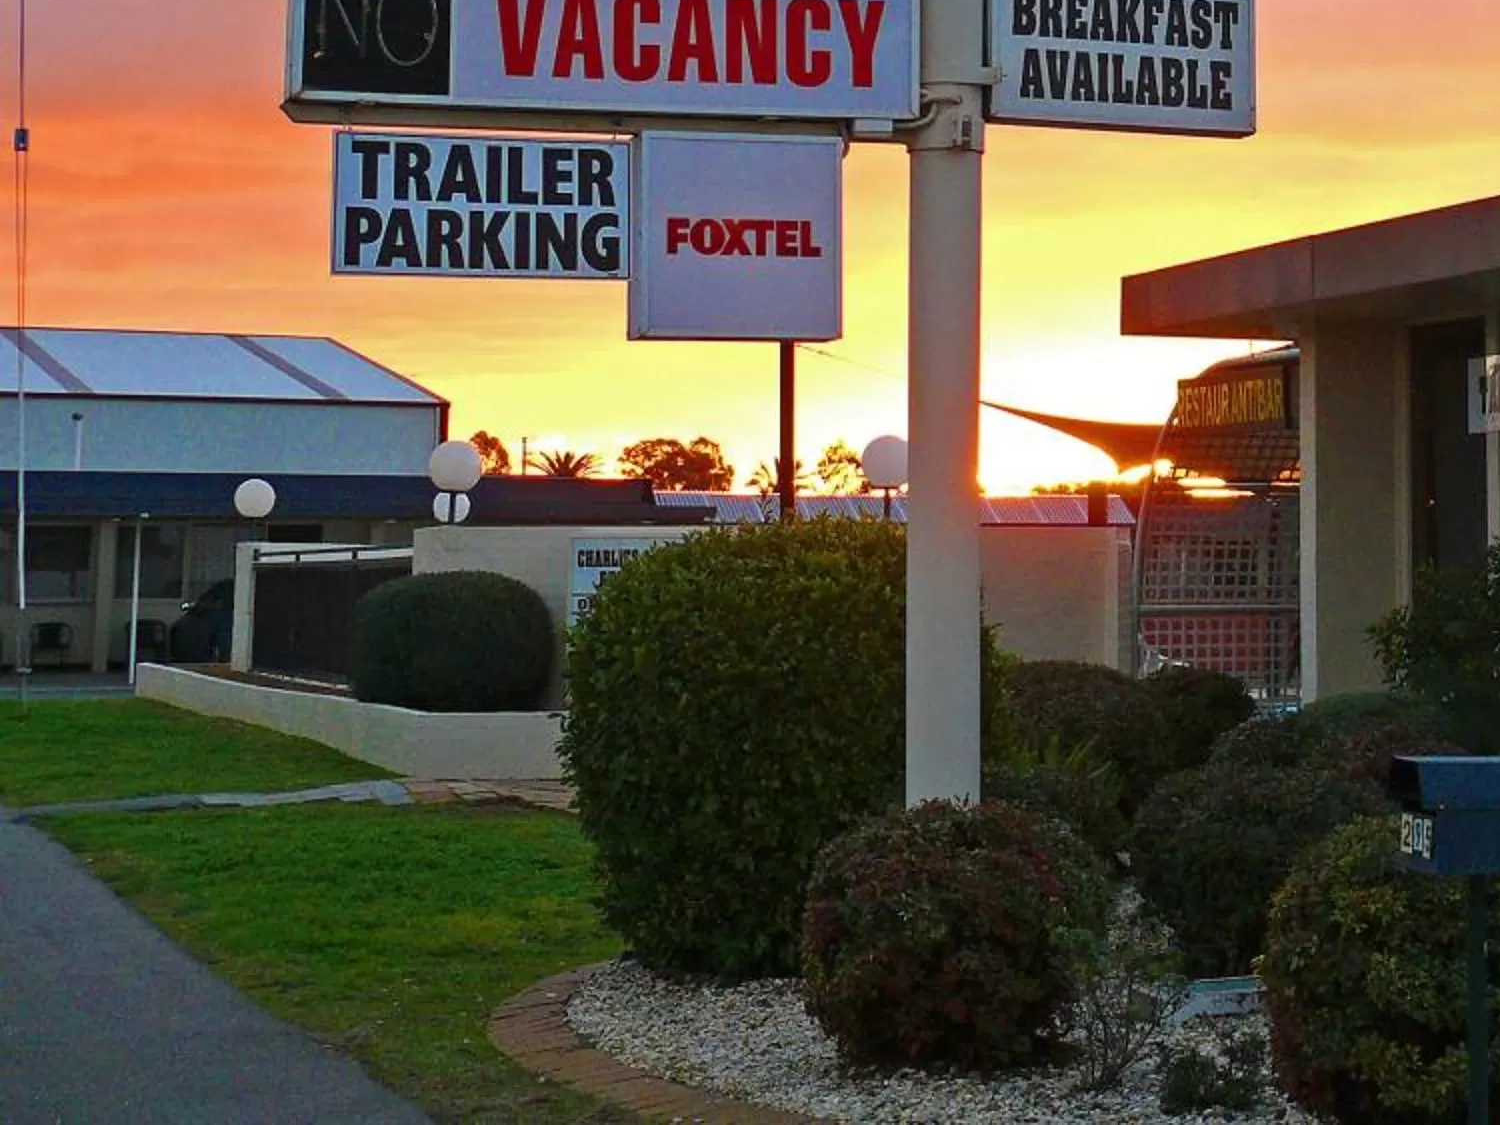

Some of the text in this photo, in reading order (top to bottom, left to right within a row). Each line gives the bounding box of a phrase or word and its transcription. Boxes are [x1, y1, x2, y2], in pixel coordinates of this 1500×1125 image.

[1019, 48, 1232, 110] AVAILABLE
[352, 140, 615, 206] TRAILER
[343, 207, 620, 273] PARKING
[665, 217, 821, 257] FOXTEL
